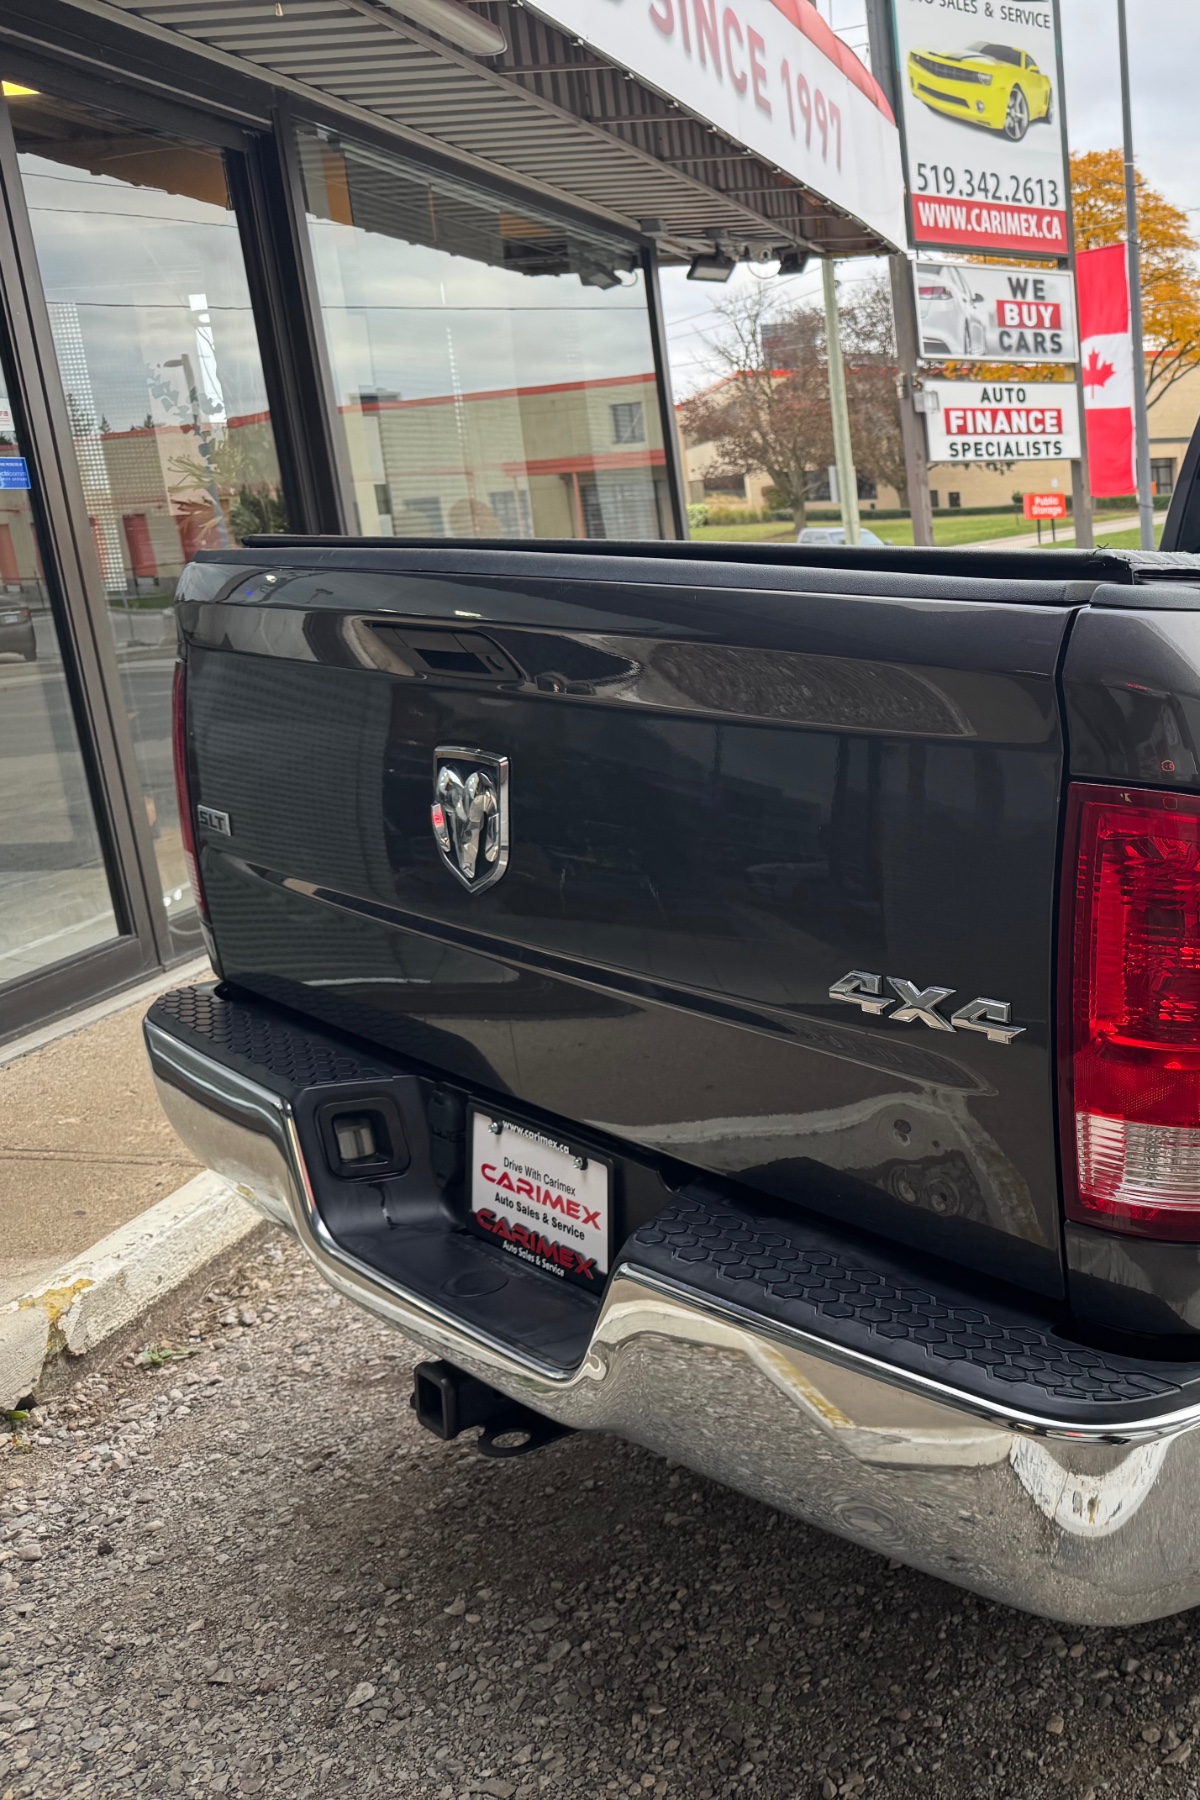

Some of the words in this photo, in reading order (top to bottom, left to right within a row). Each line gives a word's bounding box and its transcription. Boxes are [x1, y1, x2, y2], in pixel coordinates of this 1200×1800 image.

[985, 2, 993, 17] &
[1000, 6, 1051, 29] SERVICE
[781, 58, 842, 173] 1997
[917, 163, 1058, 206] 519.342.2613
[918, 202, 1062, 239] WWW.CARIMEX.CA
[1007, 277, 1045, 300] WE
[1003, 304, 1053, 328] BUY
[999, 331, 1062, 354] CARS
[980, 388, 1026, 403] AUTO
[948, 410, 1059, 434] FINANCE
[949, 441, 1062, 457] SPECIALISTS
[200, 811, 225, 831] SLT
[502, 1120, 569, 1154] www.carimex.ca
[503, 1157, 523, 1174] Drive
[524, 1165, 541, 1181] With
[543, 1175, 576, 1196] Carimex
[481, 1163, 601, 1230] CARIMEX
[494, 1192, 514, 1209] Auto
[516, 1203, 540, 1220] Sales
[542, 1213, 549, 1225] &
[551, 1217, 585, 1240] Service
[476, 1208, 594, 1280] CARIMEX
[502, 1240, 518, 1254] Auto
[518, 1247, 535, 1263] Sales
[536, 1257, 541, 1266] &
[542, 1258, 565, 1277] Service
